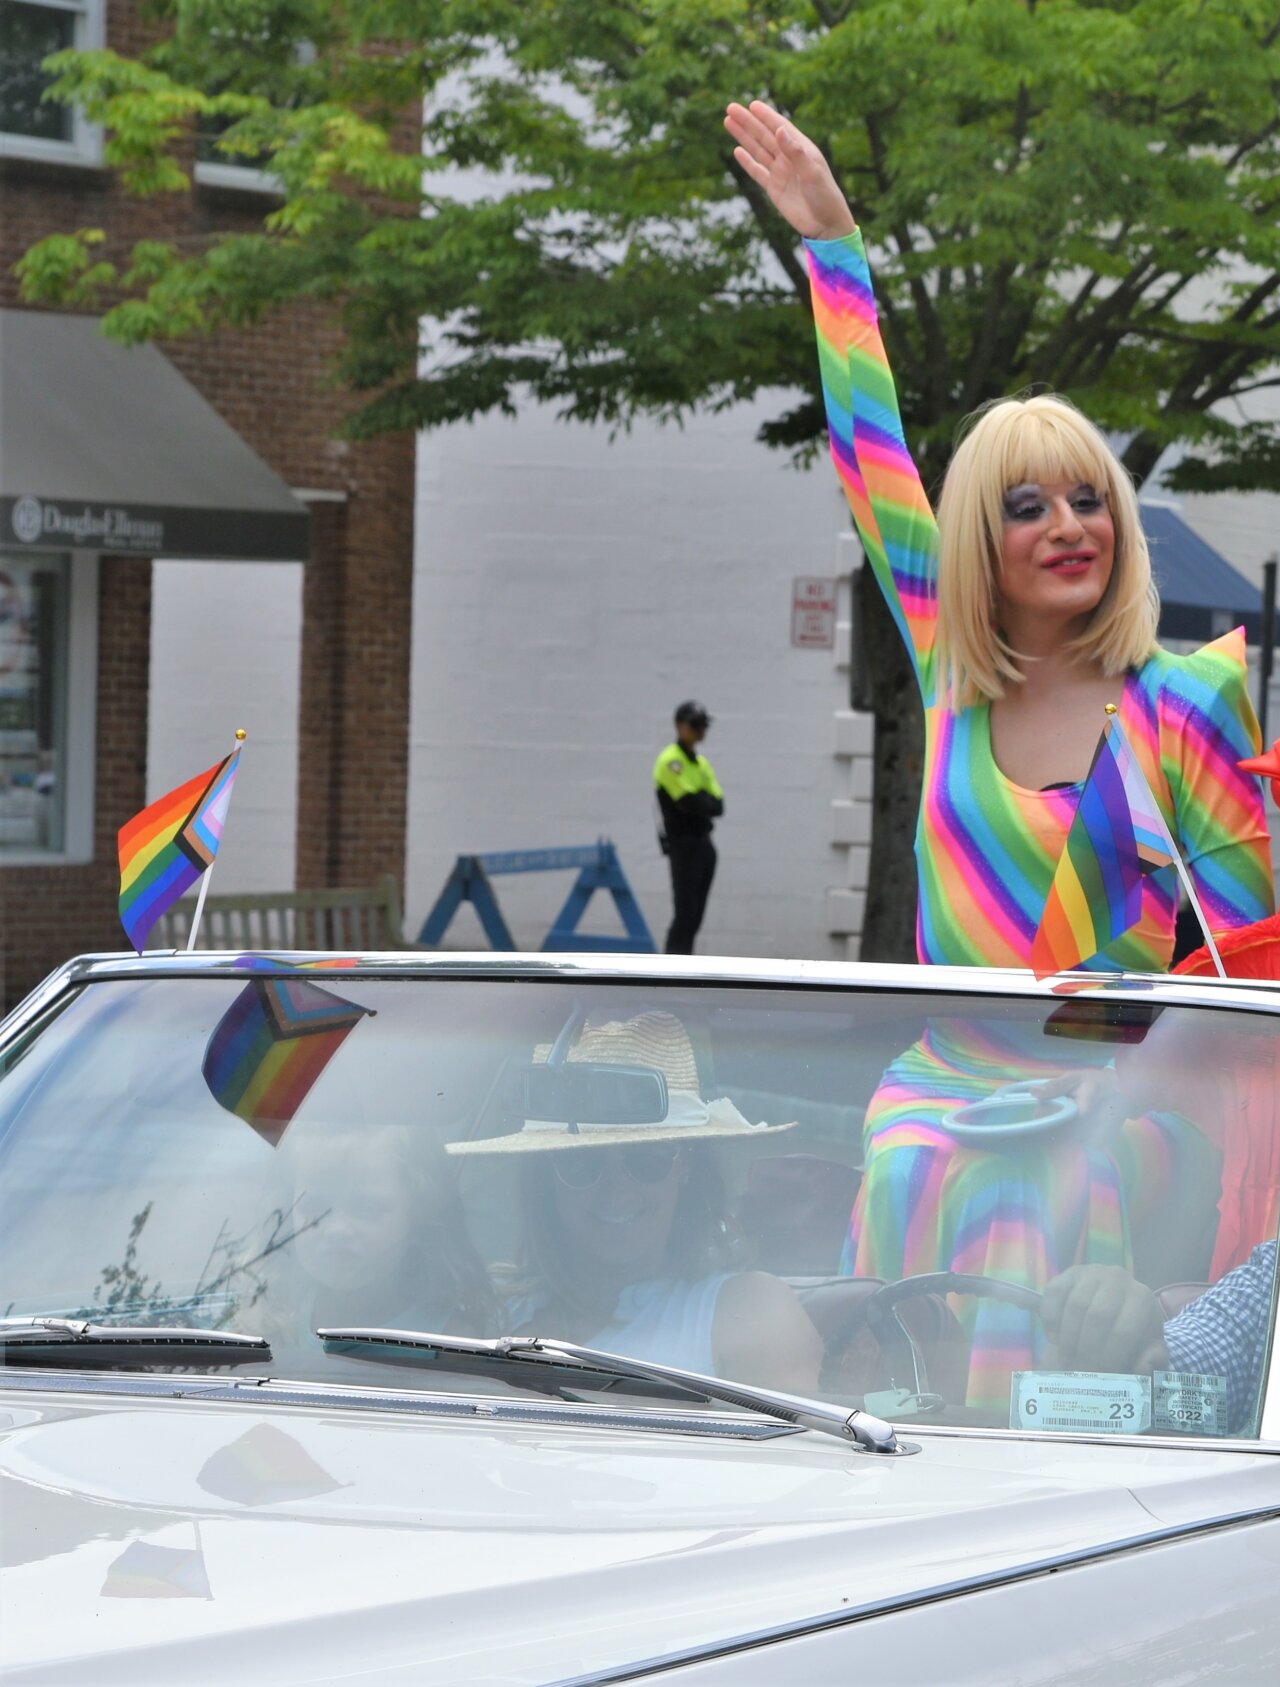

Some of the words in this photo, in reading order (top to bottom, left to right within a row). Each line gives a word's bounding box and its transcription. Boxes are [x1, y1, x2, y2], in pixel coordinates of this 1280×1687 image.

[1025, 1398, 1038, 1416] 6
[1109, 1403, 1135, 1420] 23
[1168, 1409, 1202, 1421] 2022
